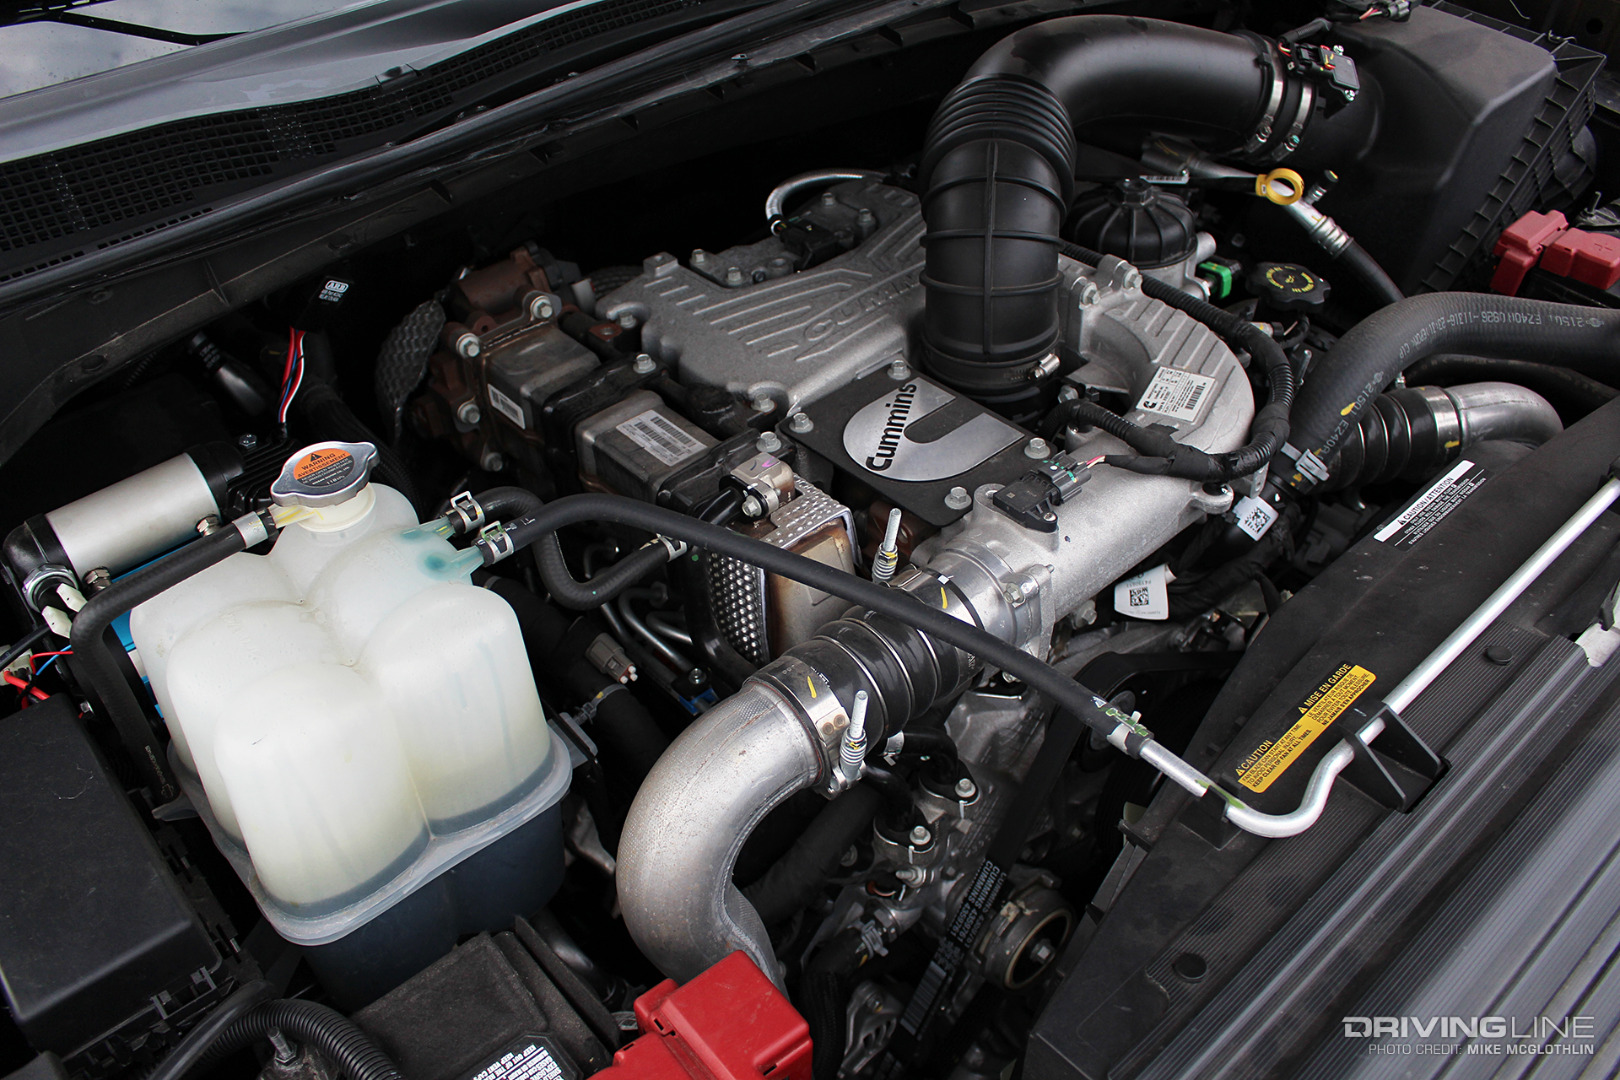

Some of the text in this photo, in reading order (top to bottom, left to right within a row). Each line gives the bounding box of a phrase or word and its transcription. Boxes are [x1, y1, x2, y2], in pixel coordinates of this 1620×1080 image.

[866, 384, 917, 471] Cummins
[302, 453, 336, 470] WARNING
[1304, 663, 1351, 707] MISE EN GARDE
[1241, 740, 1273, 770] CAUTION
[1251, 776, 1264, 787] KEEP
[1261, 764, 1276, 777] CLEAR
[1279, 751, 1289, 759] FAN
[1260, 754, 1270, 762] CAN
[968, 861, 993, 902] CUMMINS
[975, 866, 1000, 908] CUMMINS
[982, 872, 1006, 913] CUMMINS
